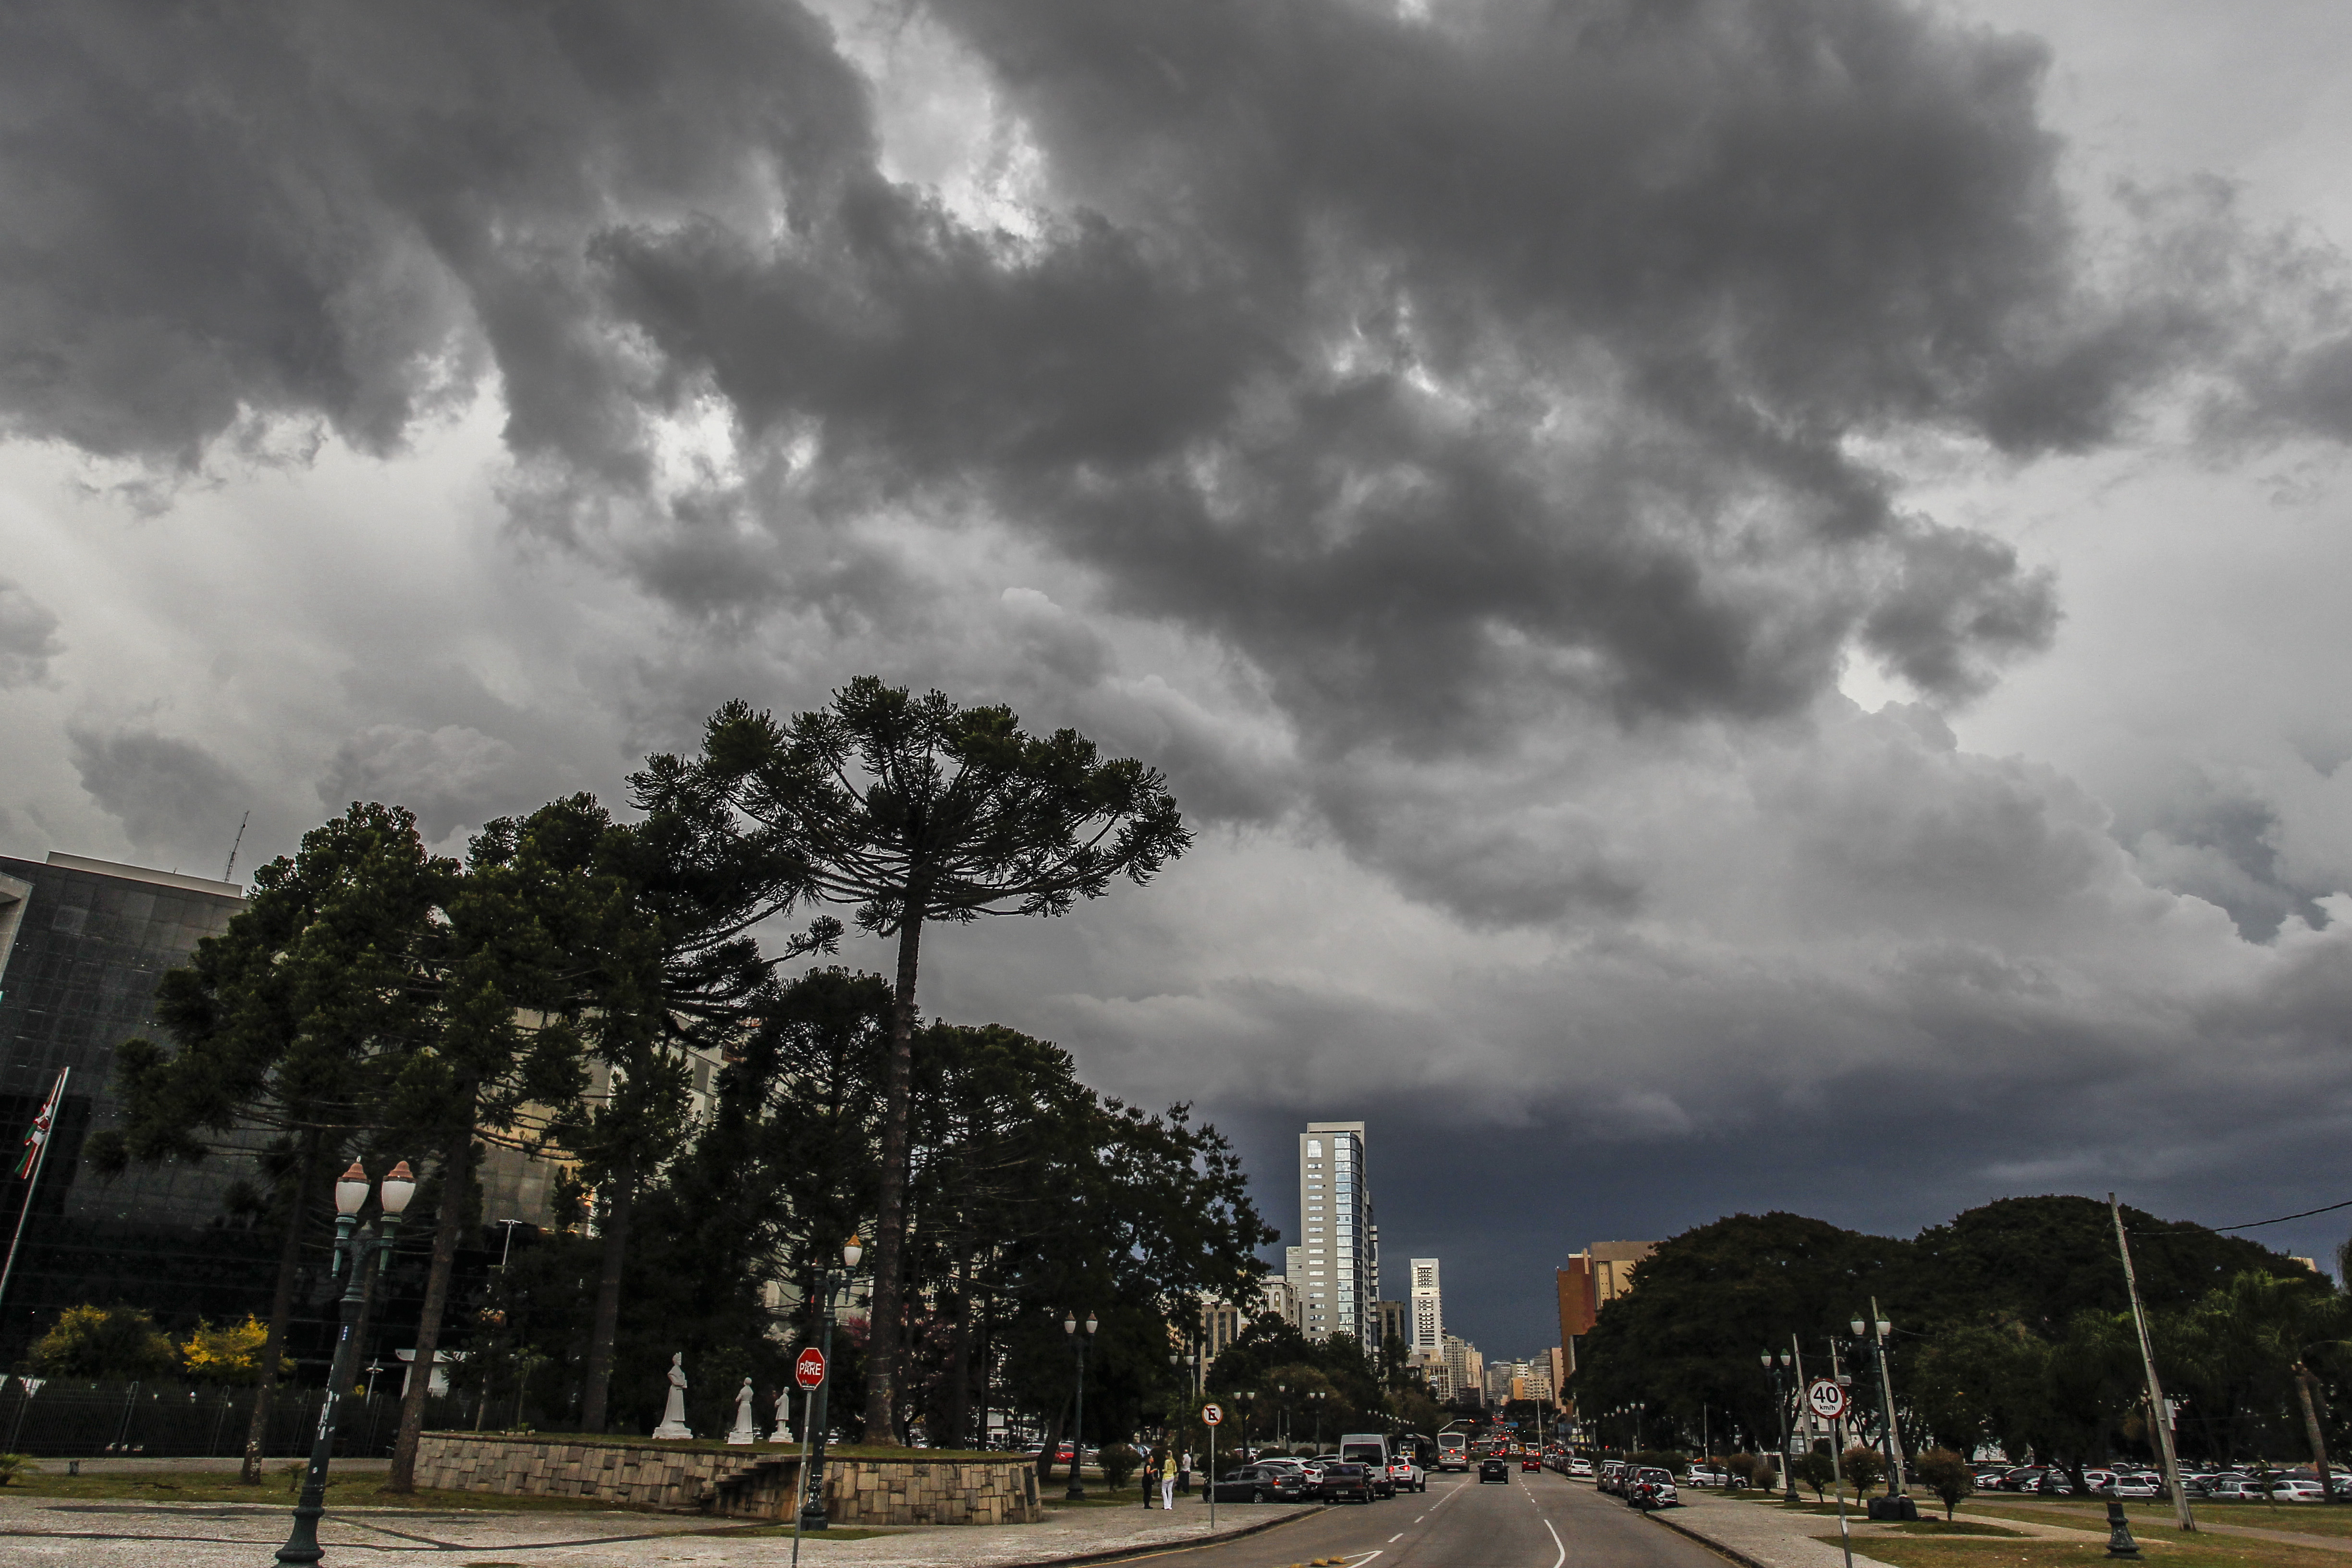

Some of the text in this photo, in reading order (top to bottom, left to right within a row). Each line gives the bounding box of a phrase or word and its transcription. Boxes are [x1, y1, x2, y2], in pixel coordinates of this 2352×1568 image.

[799, 1362, 821, 1375] PARE
[1813, 1386, 1838, 1403] 40
[1208, 1408, 1216, 1420] E
